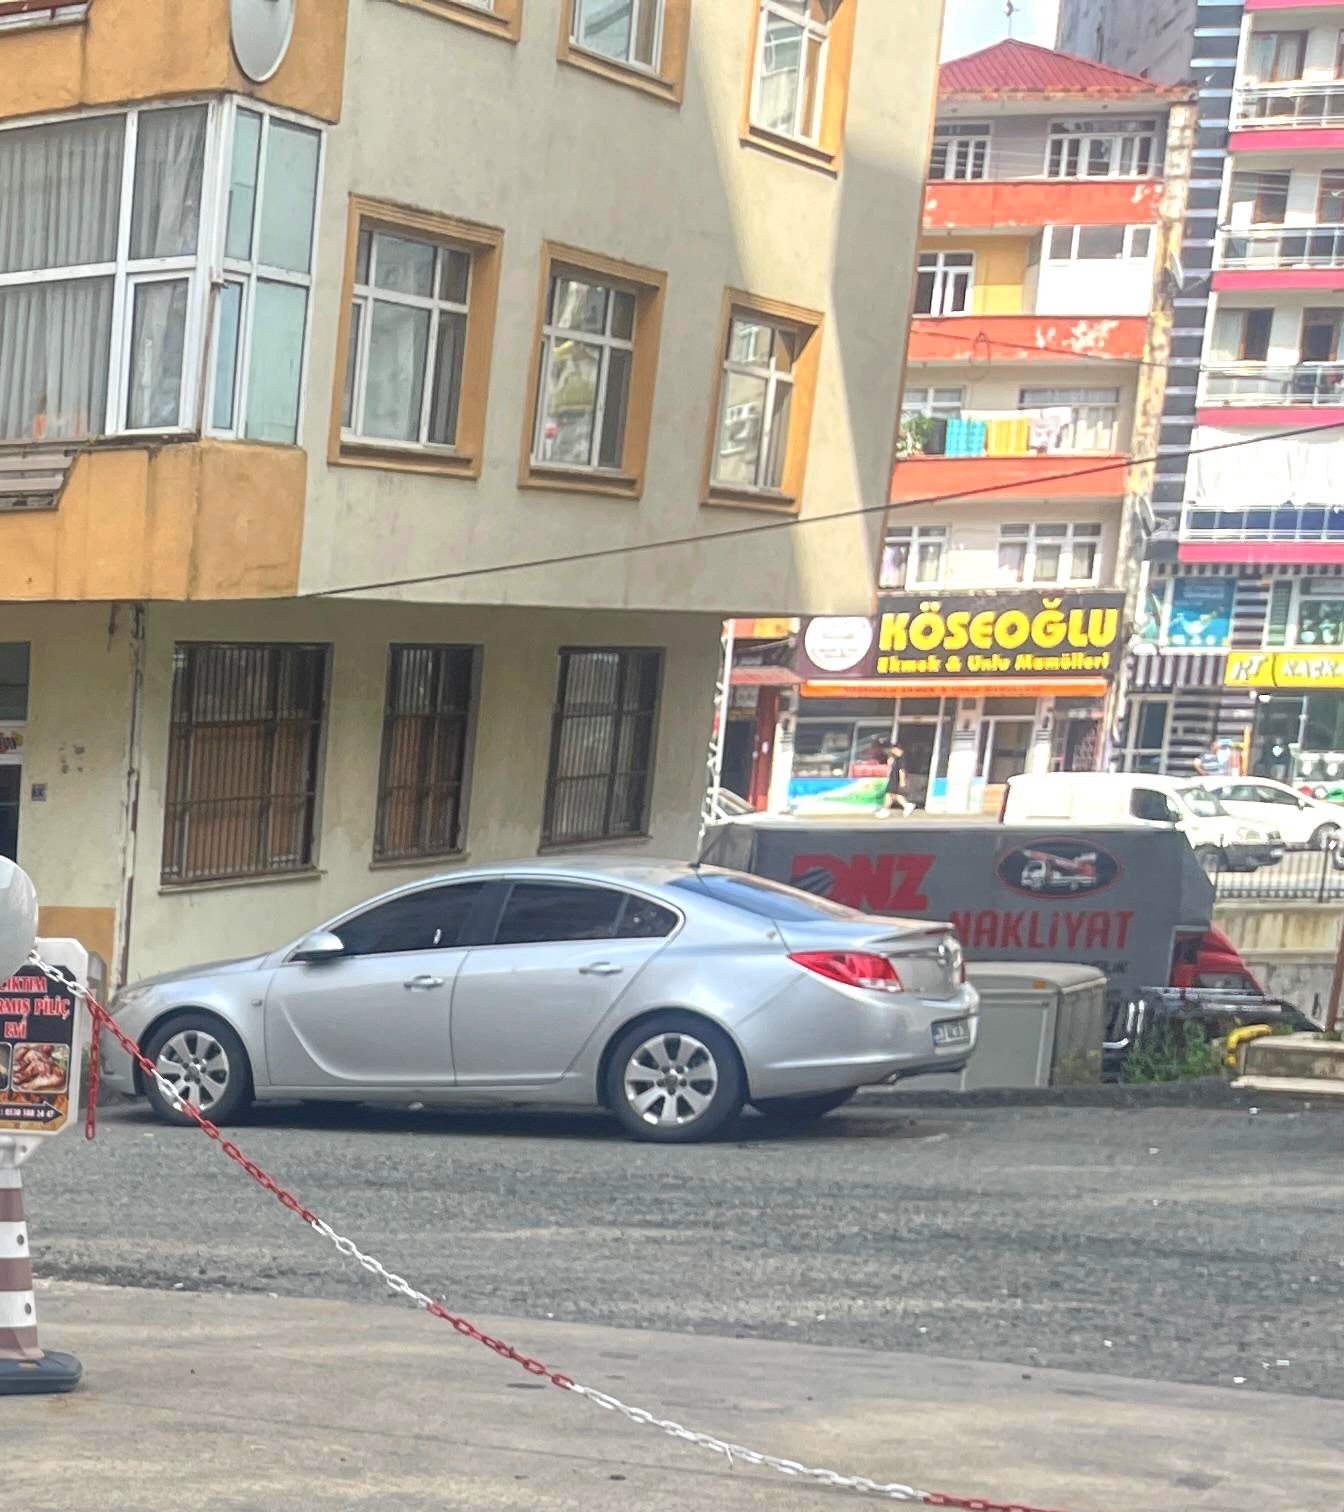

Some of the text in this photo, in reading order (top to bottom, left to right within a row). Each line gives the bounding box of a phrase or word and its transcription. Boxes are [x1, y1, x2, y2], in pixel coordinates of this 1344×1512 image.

[878, 597, 1119, 651] KÖSEOĞLU
[876, 655, 940, 674] Ekmek
[944, 655, 962, 673] &
[949, 909, 1135, 950] NAKLİYAT
[34, 994, 72, 1020] PİLİÇ
